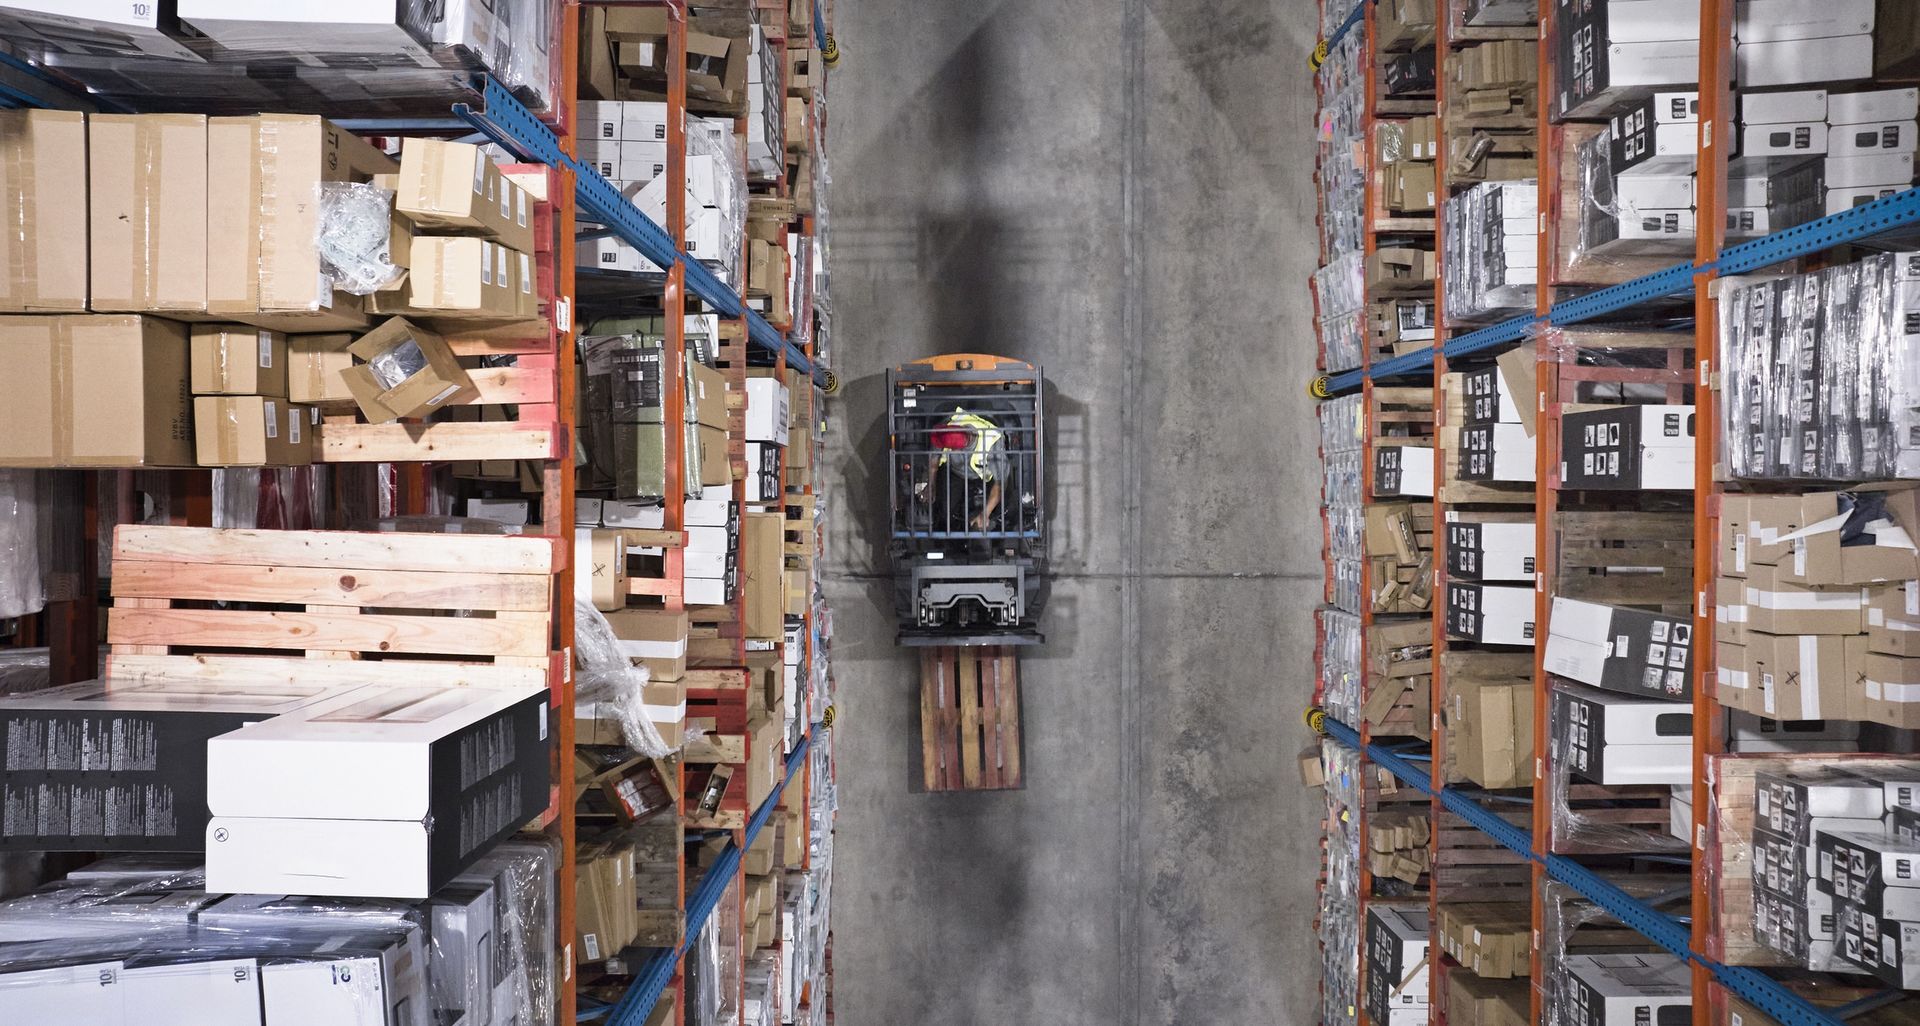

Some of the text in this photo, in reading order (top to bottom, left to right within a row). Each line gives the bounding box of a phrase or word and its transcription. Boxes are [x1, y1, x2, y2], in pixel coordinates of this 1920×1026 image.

[132, 3, 145, 15] 10
[100, 973, 112, 986] 10
[234, 970, 246, 982] 10
